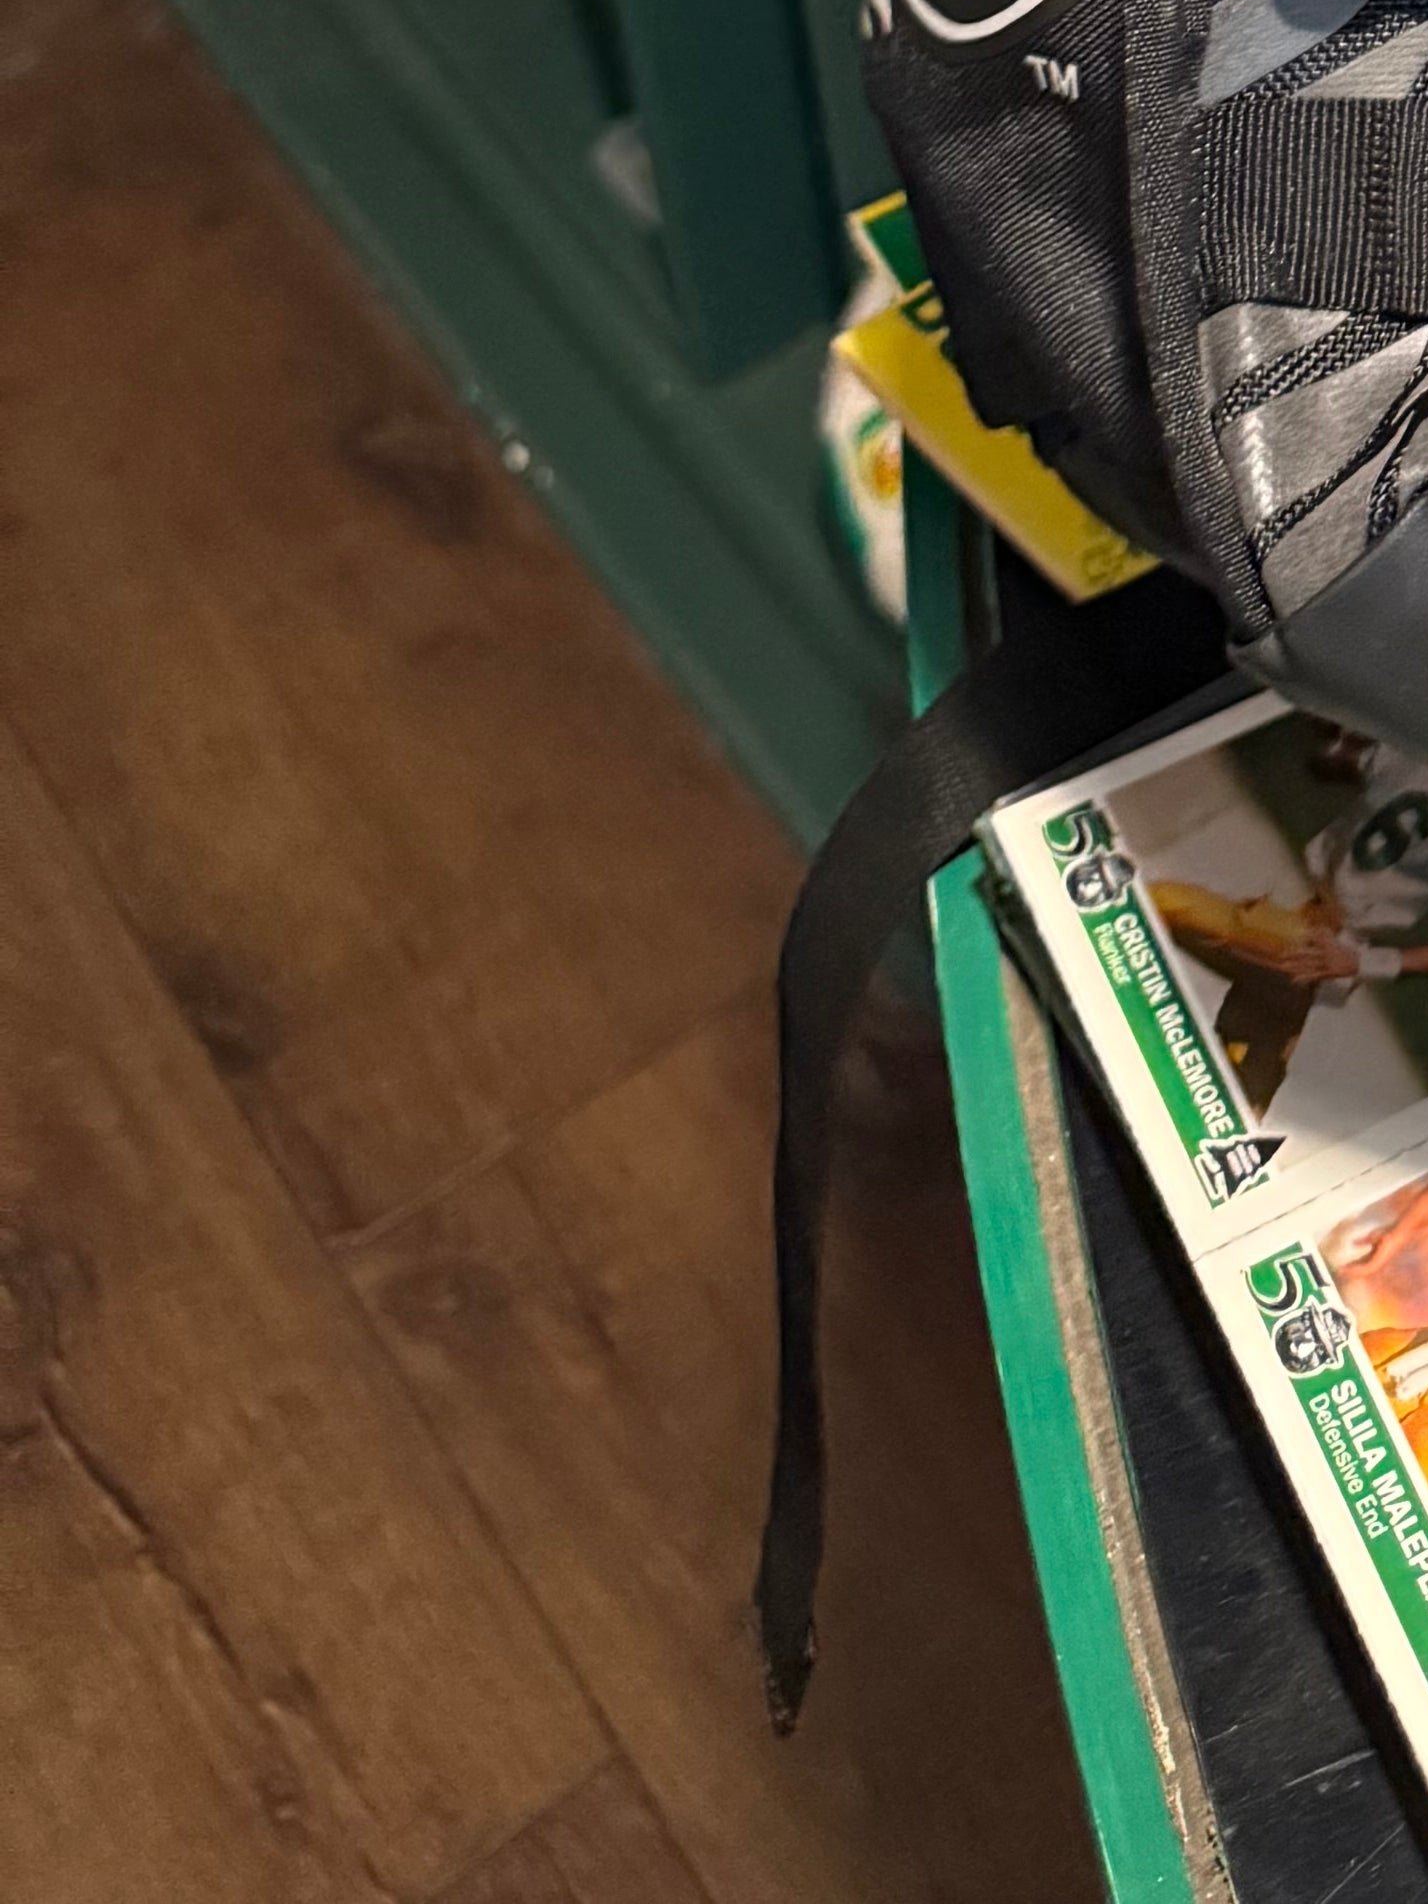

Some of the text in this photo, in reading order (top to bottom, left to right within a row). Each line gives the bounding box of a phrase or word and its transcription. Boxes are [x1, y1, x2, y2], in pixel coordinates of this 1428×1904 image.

[1022, 53, 1081, 101] TM
[1112, 912, 1236, 1139] CRISTIN McLEMORE
[1308, 1394, 1389, 1541] Defensive End
[1330, 1377, 1388, 1473] SILILA
